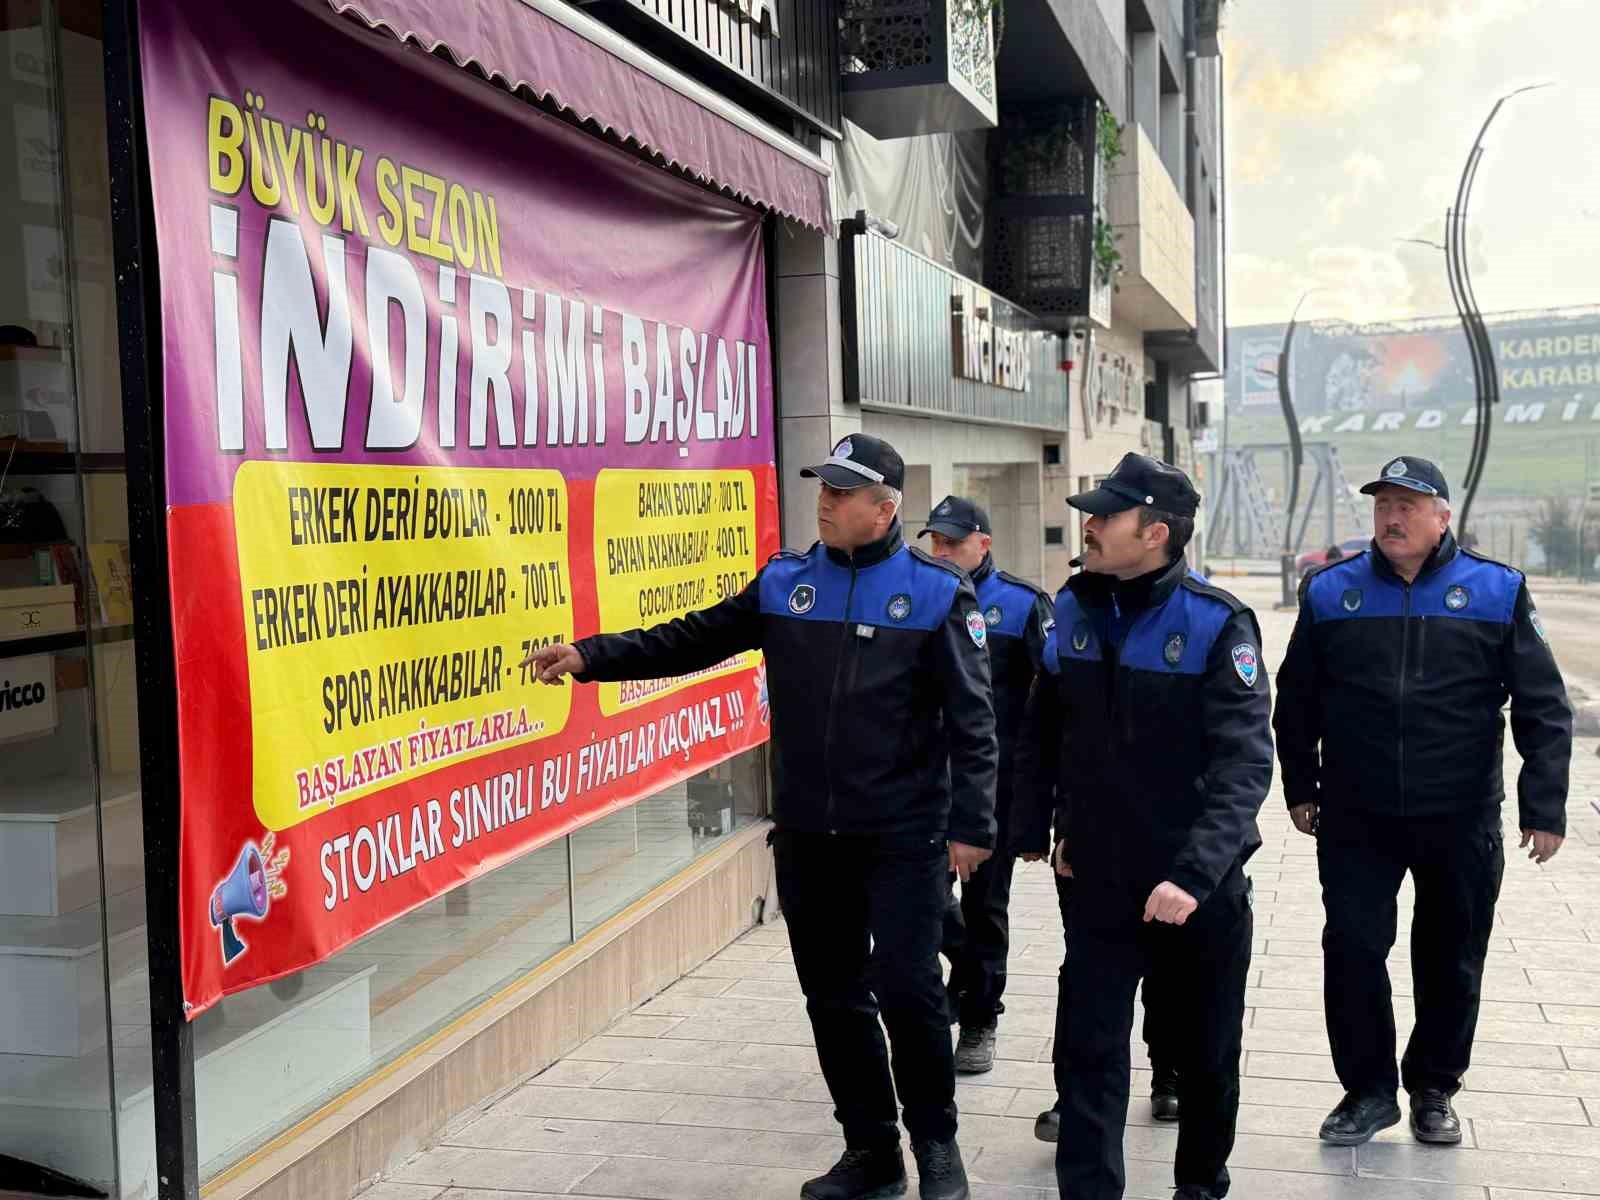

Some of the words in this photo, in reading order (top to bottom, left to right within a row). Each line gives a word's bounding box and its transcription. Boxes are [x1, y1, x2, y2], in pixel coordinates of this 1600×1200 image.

[208, 90, 370, 237] BÜYÜK
[376, 156, 503, 278] SEZON
[210, 203, 605, 452] İNDİRİMİ
[621, 311, 758, 457] BAŞLADI
[1503, 364, 1600, 389] KARAB
[288, 486, 359, 545] ERKEK
[365, 475, 419, 542] DERİ
[424, 487, 491, 539] BOTLAR
[508, 487, 544, 534] 1000
[547, 487, 562, 533] TL
[638, 482, 672, 518] BAYAN
[674, 480, 712, 515] BOTLAR
[733, 480, 748, 511] TL
[607, 536, 645, 576] BAYAN
[648, 529, 709, 570] AYAKKABILAR
[715, 527, 735, 559] 400
[737, 526, 749, 556] TL
[252, 583, 321, 651] ERKEK
[323, 564, 369, 639] DERİ
[373, 567, 507, 631] AYAKKABILAR
[521, 562, 548, 611] 700
[548, 561, 566, 606] TL
[639, 583, 674, 626] ÇOCUK
[676, 577, 705, 610] BOTLAR
[716, 571, 737, 599] 500
[322, 668, 375, 734] SPOR
[378, 645, 503, 719] AYAKKABILAR
[296, 740, 403, 809] BAŞLAYAN
[409, 708, 545, 767] FİYATLARLA...
[319, 798, 446, 911] STOKLAR
[450, 764, 534, 848] SINIRLI
[540, 751, 573, 811] BU
[575, 722, 657, 795] FİYATLAR
[657, 696, 726, 762] KAÇMAZ
[726, 689, 745, 731] !!!
